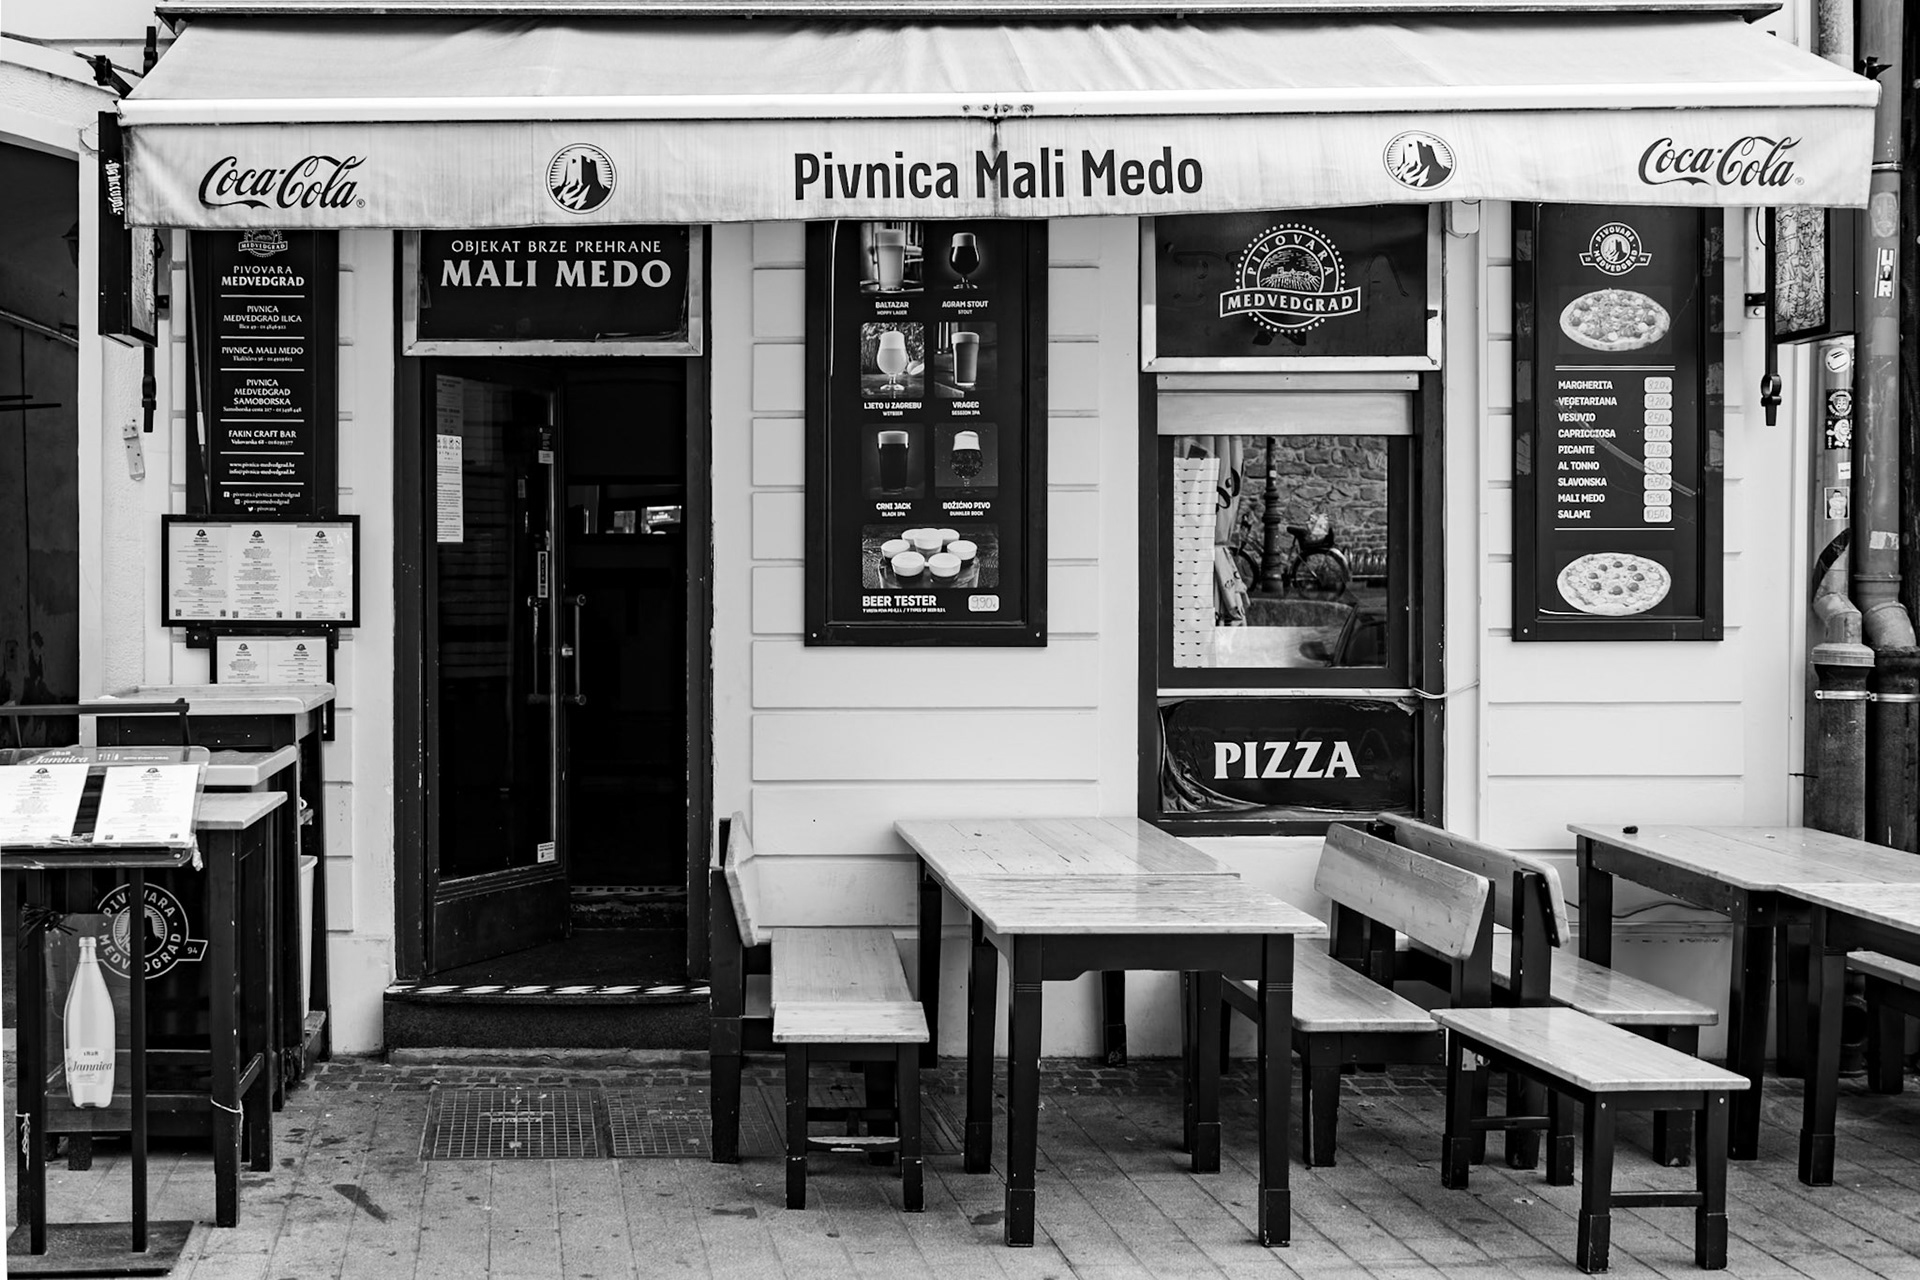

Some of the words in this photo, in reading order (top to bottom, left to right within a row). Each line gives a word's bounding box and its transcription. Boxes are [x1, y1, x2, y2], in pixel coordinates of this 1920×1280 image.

[1638, 136, 1803, 187] Coca-Cola
[795, 151, 958, 200] Pivnica
[975, 147, 1064, 199] Mali
[1082, 146, 1203, 197] Medo
[199, 156, 367, 209] Coca-Cola
[1596, 226, 1634, 242] PIVOVARA
[451, 240, 520, 255] OBJEKAT
[528, 240, 567, 252] BRZE
[576, 240, 662, 252] PREHRANE
[1247, 234, 1334, 276] PIVOVARA
[1593, 250, 1638, 272] MEDVEDGRAD
[233, 265, 292, 274] PIVOVARA
[440, 260, 536, 287] MALI
[554, 260, 672, 288] MEDO
[221, 276, 304, 286] MEDVEDGRAD
[1228, 294, 1352, 312] MEDVEDGRAD
[222, 346, 254, 354] PIVNICA
[256, 346, 276, 354] MALI
[278, 346, 304, 354] MEDO
[246, 378, 278, 386] PIVNICA
[1558, 381, 1613, 390] MARGHERITA
[1558, 397, 1617, 406] VEGETARIANA
[1558, 413, 1596, 422] VESUVIO
[1558, 429, 1616, 438] CAPRICCIOSA
[1558, 446, 1595, 454] PICANTE
[1558, 462, 1569, 470] AL
[1570, 462, 1600, 470] TONNO
[1558, 478, 1607, 486] SLAVONSKA
[1558, 494, 1580, 502] MALI
[1581, 494, 1605, 502] MEDO
[1558, 510, 1591, 519] SALAMI
[862, 595, 892, 606] BEER
[894, 595, 936, 606] TESTER
[26, 755, 89, 764] Jamnica
[1214, 741, 1361, 780] PIZZA
[103, 890, 176, 918] PIVARA
[99, 934, 181, 972] MEDVDGRAD
[68, 1060, 112, 1072] Jamnica
